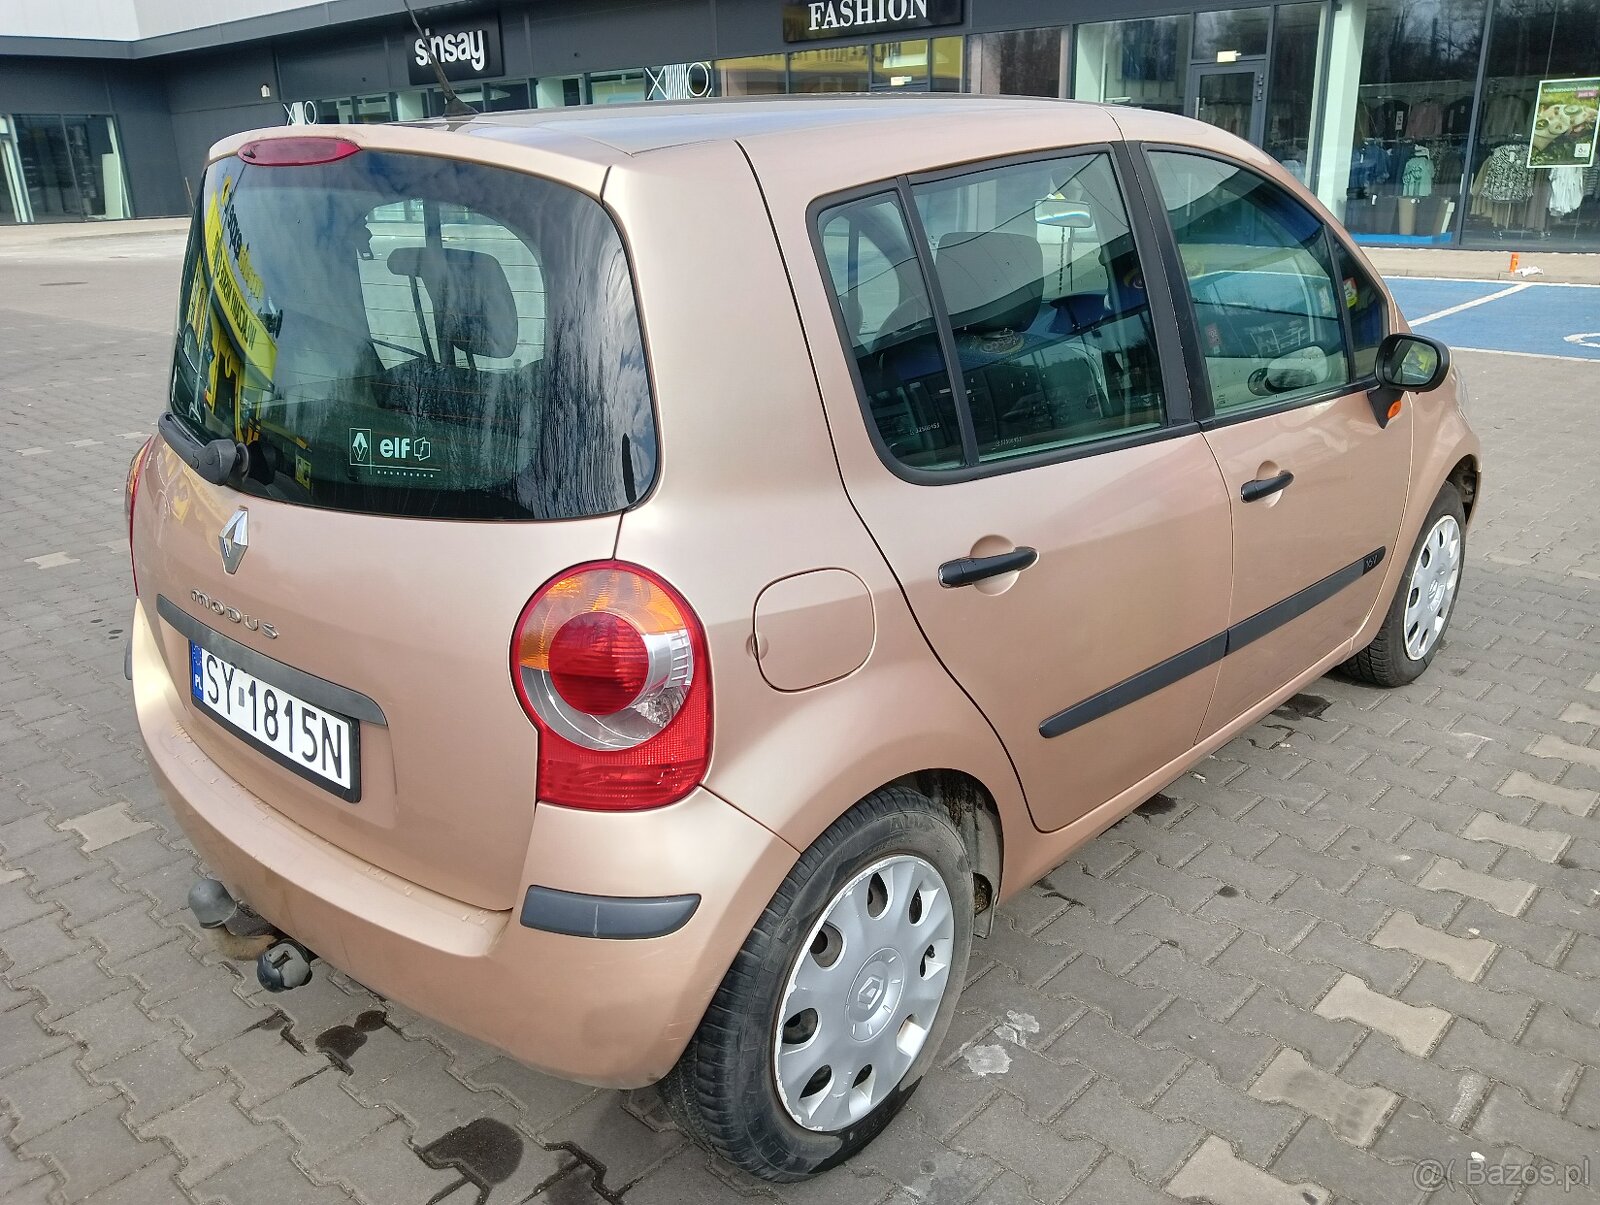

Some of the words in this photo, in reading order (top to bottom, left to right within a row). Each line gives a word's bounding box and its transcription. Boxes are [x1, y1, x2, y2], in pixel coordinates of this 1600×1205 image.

[808, 0, 927, 30] FASHION
[414, 28, 485, 71] sinsay
[379, 437, 411, 459] elf
[194, 673, 203, 691] PL
[248, 679, 342, 779] 1815N
